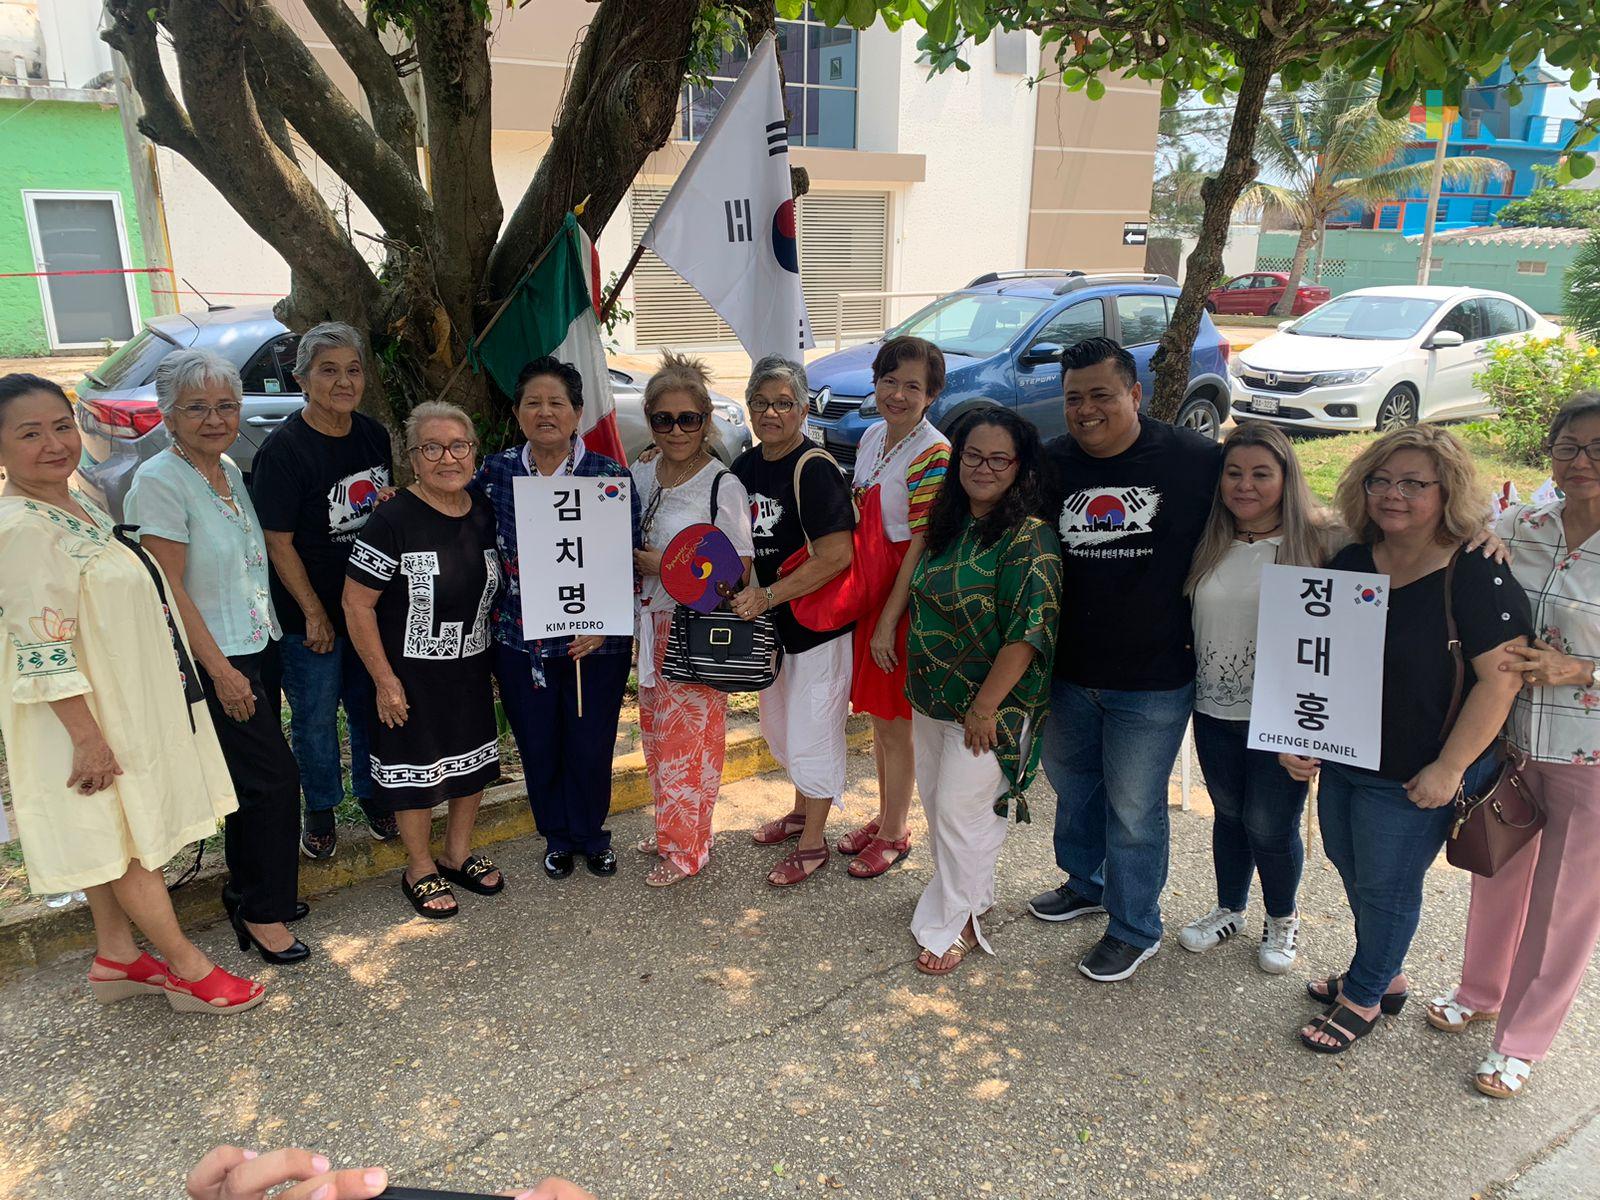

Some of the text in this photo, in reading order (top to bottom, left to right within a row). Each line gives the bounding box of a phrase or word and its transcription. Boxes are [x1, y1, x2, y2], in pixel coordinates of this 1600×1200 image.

[553, 489, 586, 614] 김치명
[546, 621, 604, 632] KIM PEDRO
[1259, 732, 1358, 758] CHENGE DANIEL
